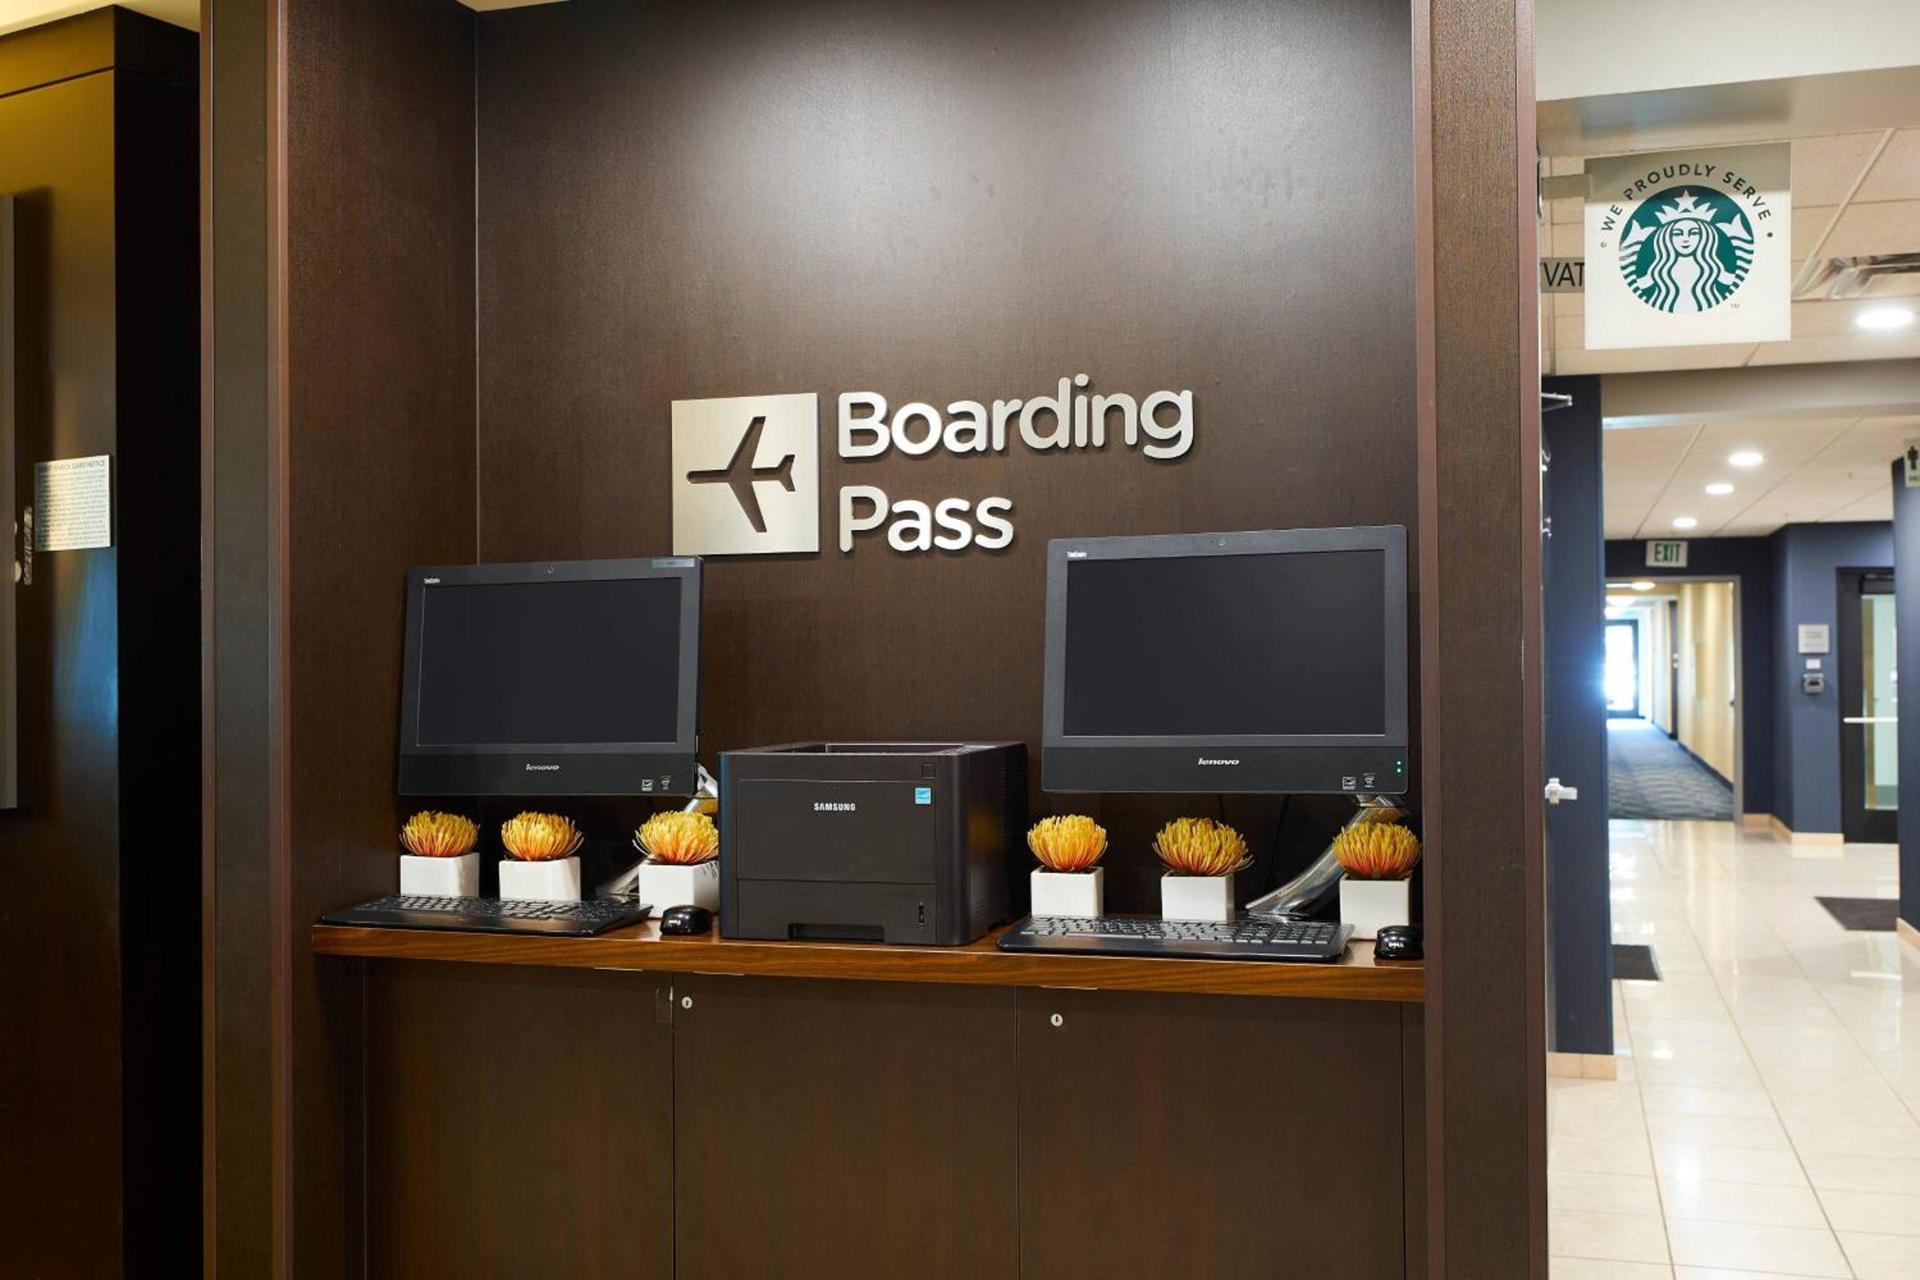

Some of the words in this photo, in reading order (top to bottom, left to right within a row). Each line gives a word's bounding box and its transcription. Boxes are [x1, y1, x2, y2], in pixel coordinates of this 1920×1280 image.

[1601, 203, 1623, 233] WE
[1623, 163, 1716, 201] PROUDLY
[1722, 171, 1772, 221] SERVE
[1541, 261, 1585, 287] VAT
[837, 373, 1195, 460] Boarding
[838, 485, 1015, 553] Pass
[1654, 542, 1681, 563] EXIT
[525, 763, 560, 771] lenovo
[1197, 757, 1240, 766] lenovo
[813, 802, 856, 811] SAMSUNG
